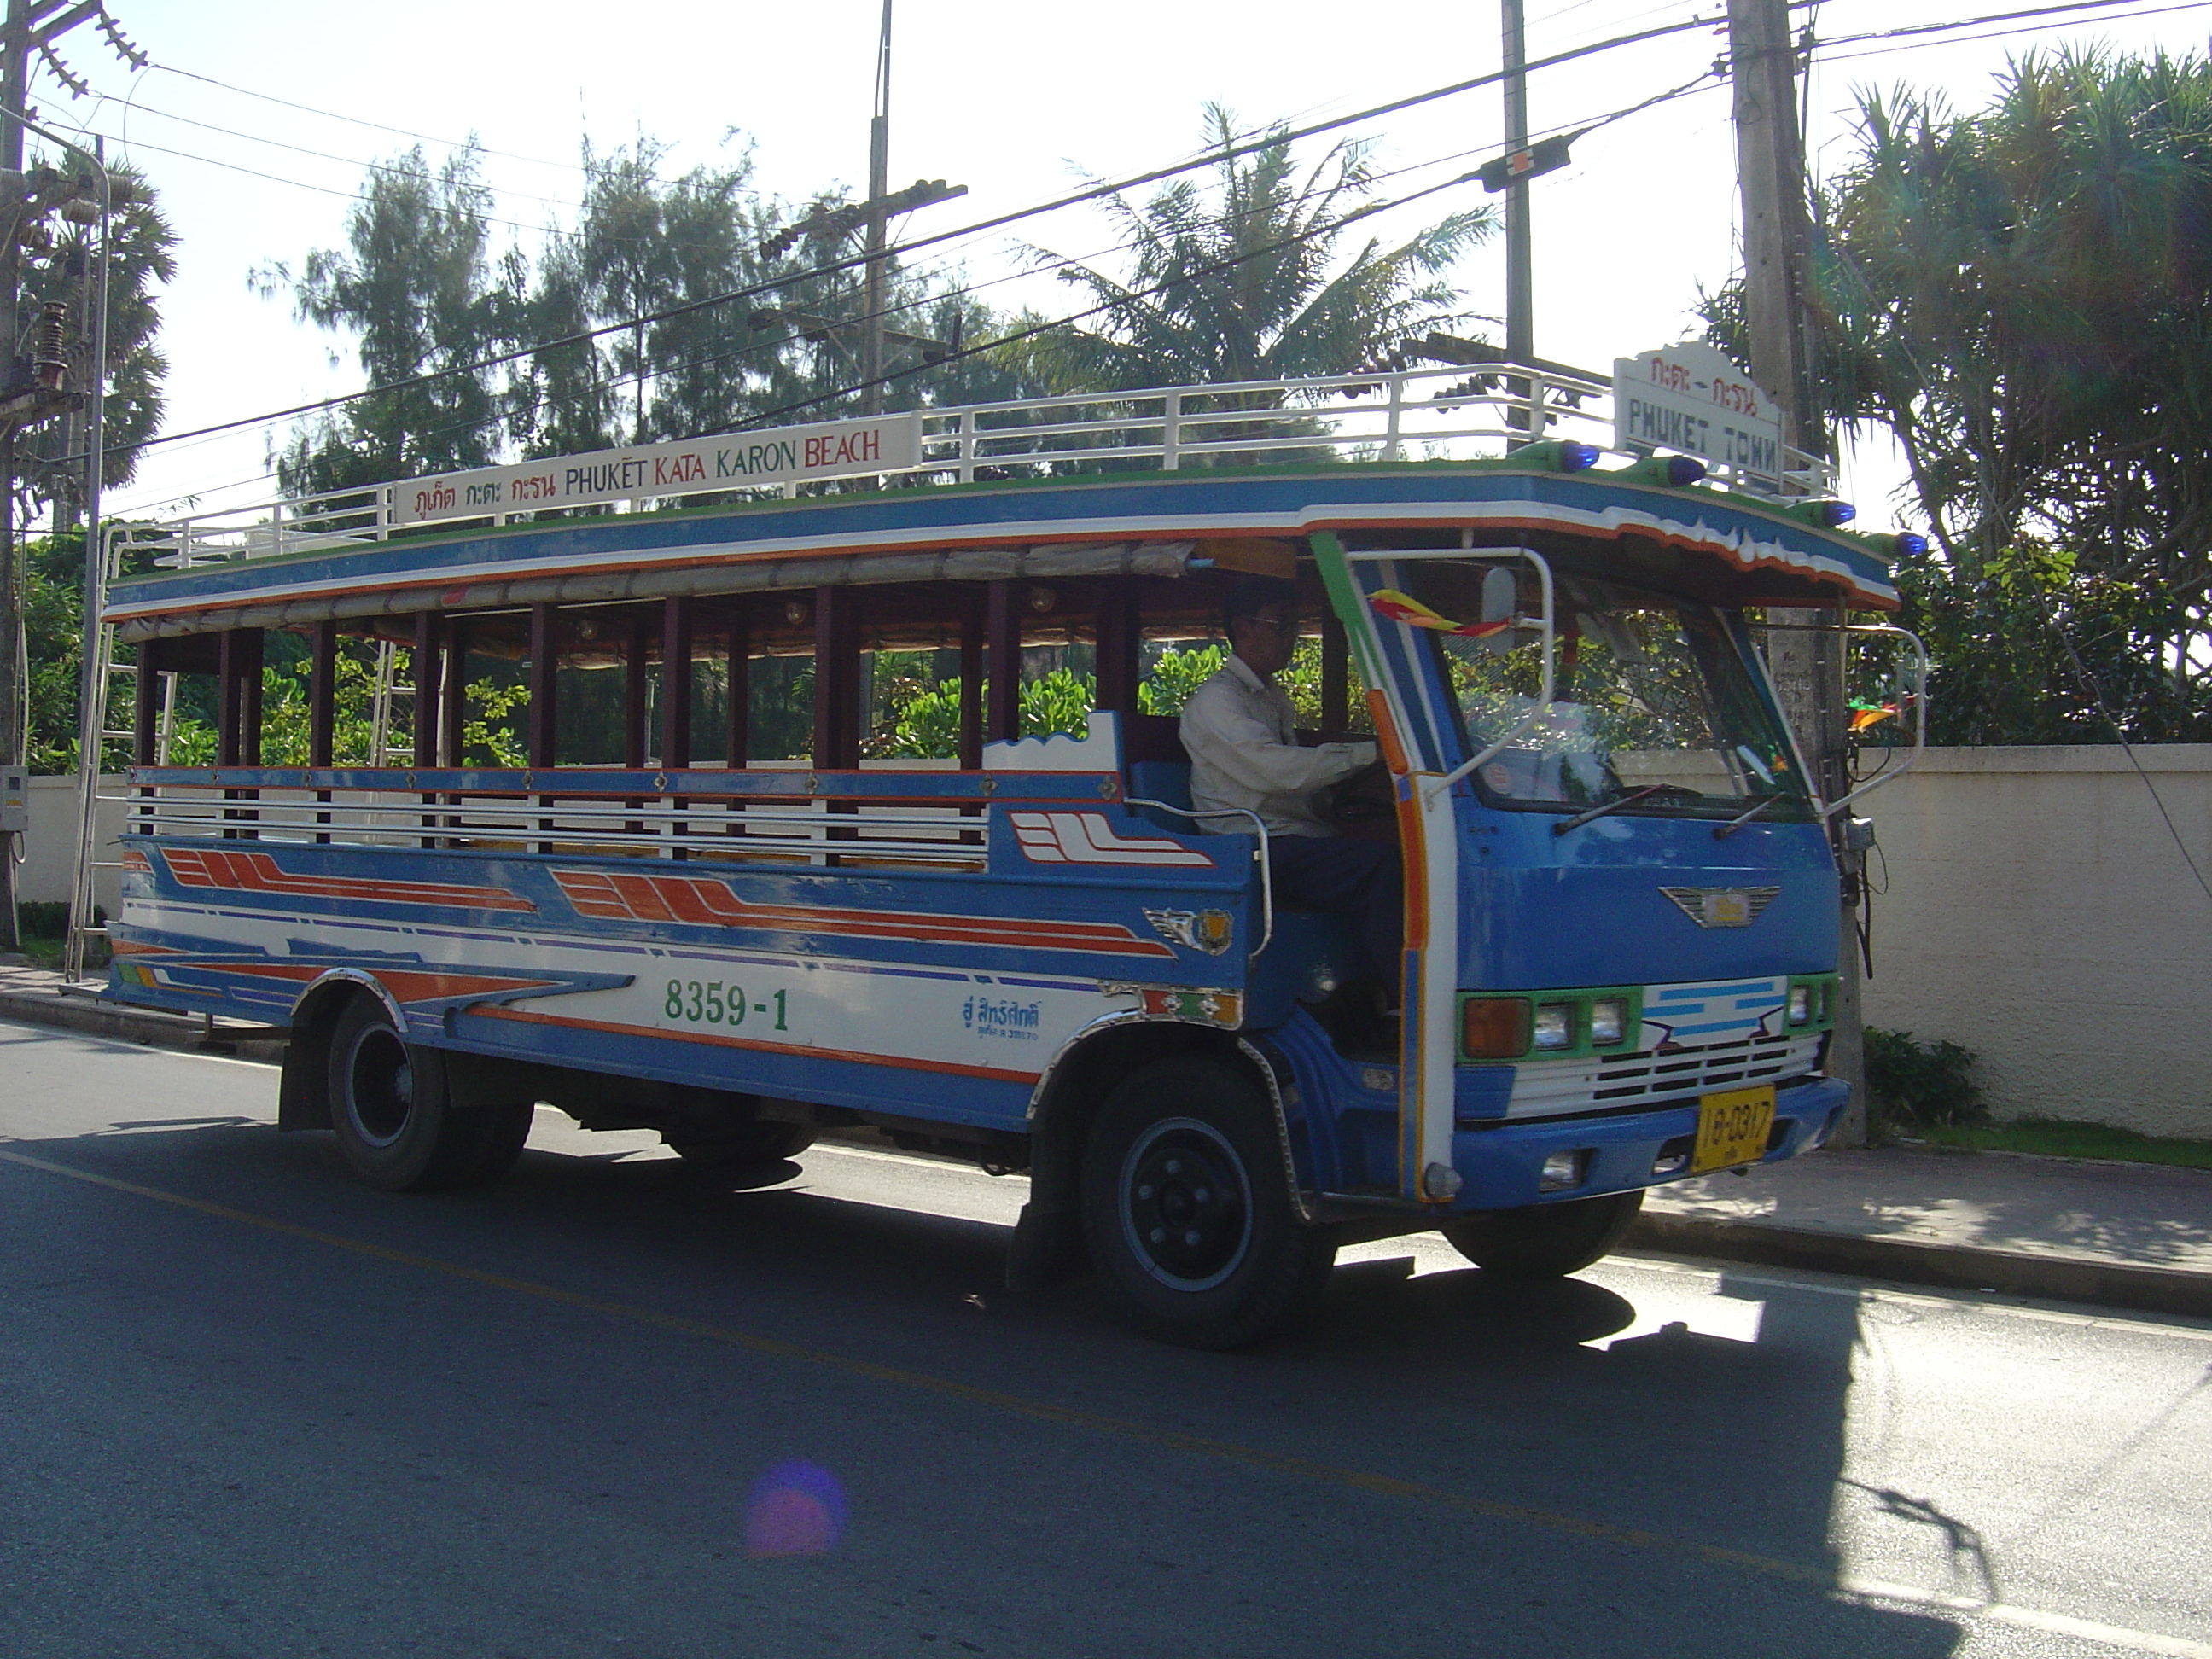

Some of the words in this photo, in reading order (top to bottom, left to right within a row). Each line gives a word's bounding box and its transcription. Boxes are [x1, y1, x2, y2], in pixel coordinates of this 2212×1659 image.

[1651, 357, 1690, 391] กะตะ
[1712, 377, 1758, 416] กะรน
[1629, 398, 1709, 453] PHUKET
[415, 481, 455, 519] ภูเก็ต
[466, 482, 502, 506] กะตะ
[511, 474, 556, 501] กะรน
[655, 452, 706, 486] KATA
[717, 441, 796, 477] KARON
[805, 429, 881, 468] BEACH
[665, 978, 789, 1032] 8359-1
